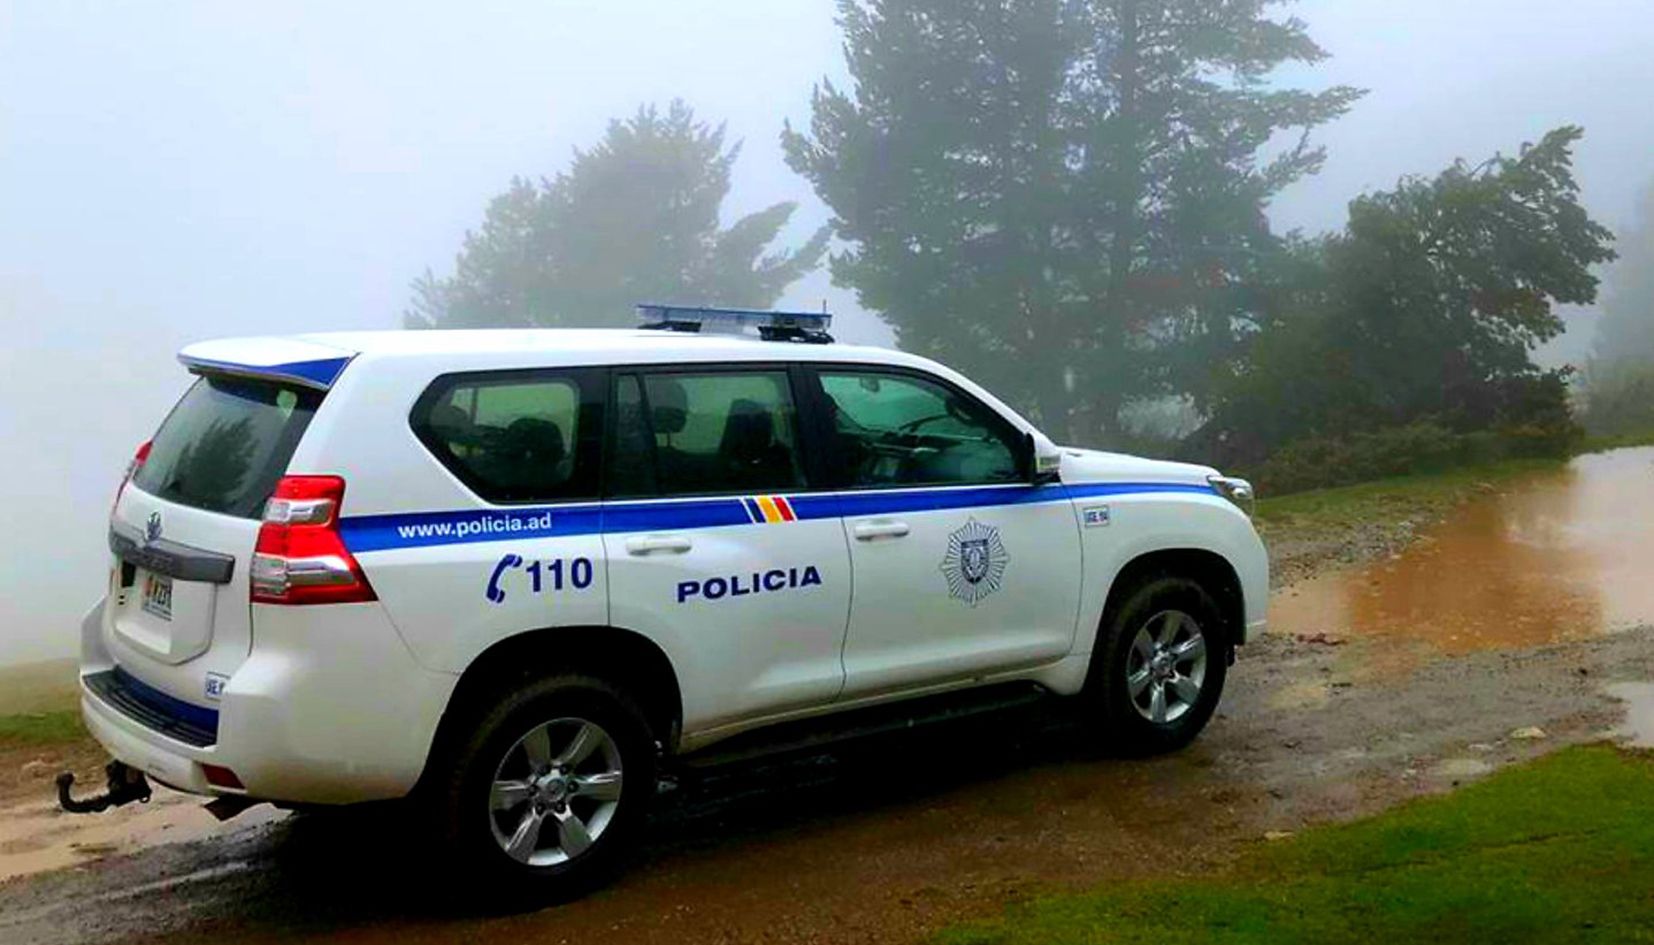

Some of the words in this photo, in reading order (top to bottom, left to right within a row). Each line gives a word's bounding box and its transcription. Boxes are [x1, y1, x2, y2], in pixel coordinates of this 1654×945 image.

[397, 511, 553, 539] www.policia.ad
[526, 556, 593, 592] 110
[677, 565, 822, 603] POLICIA
